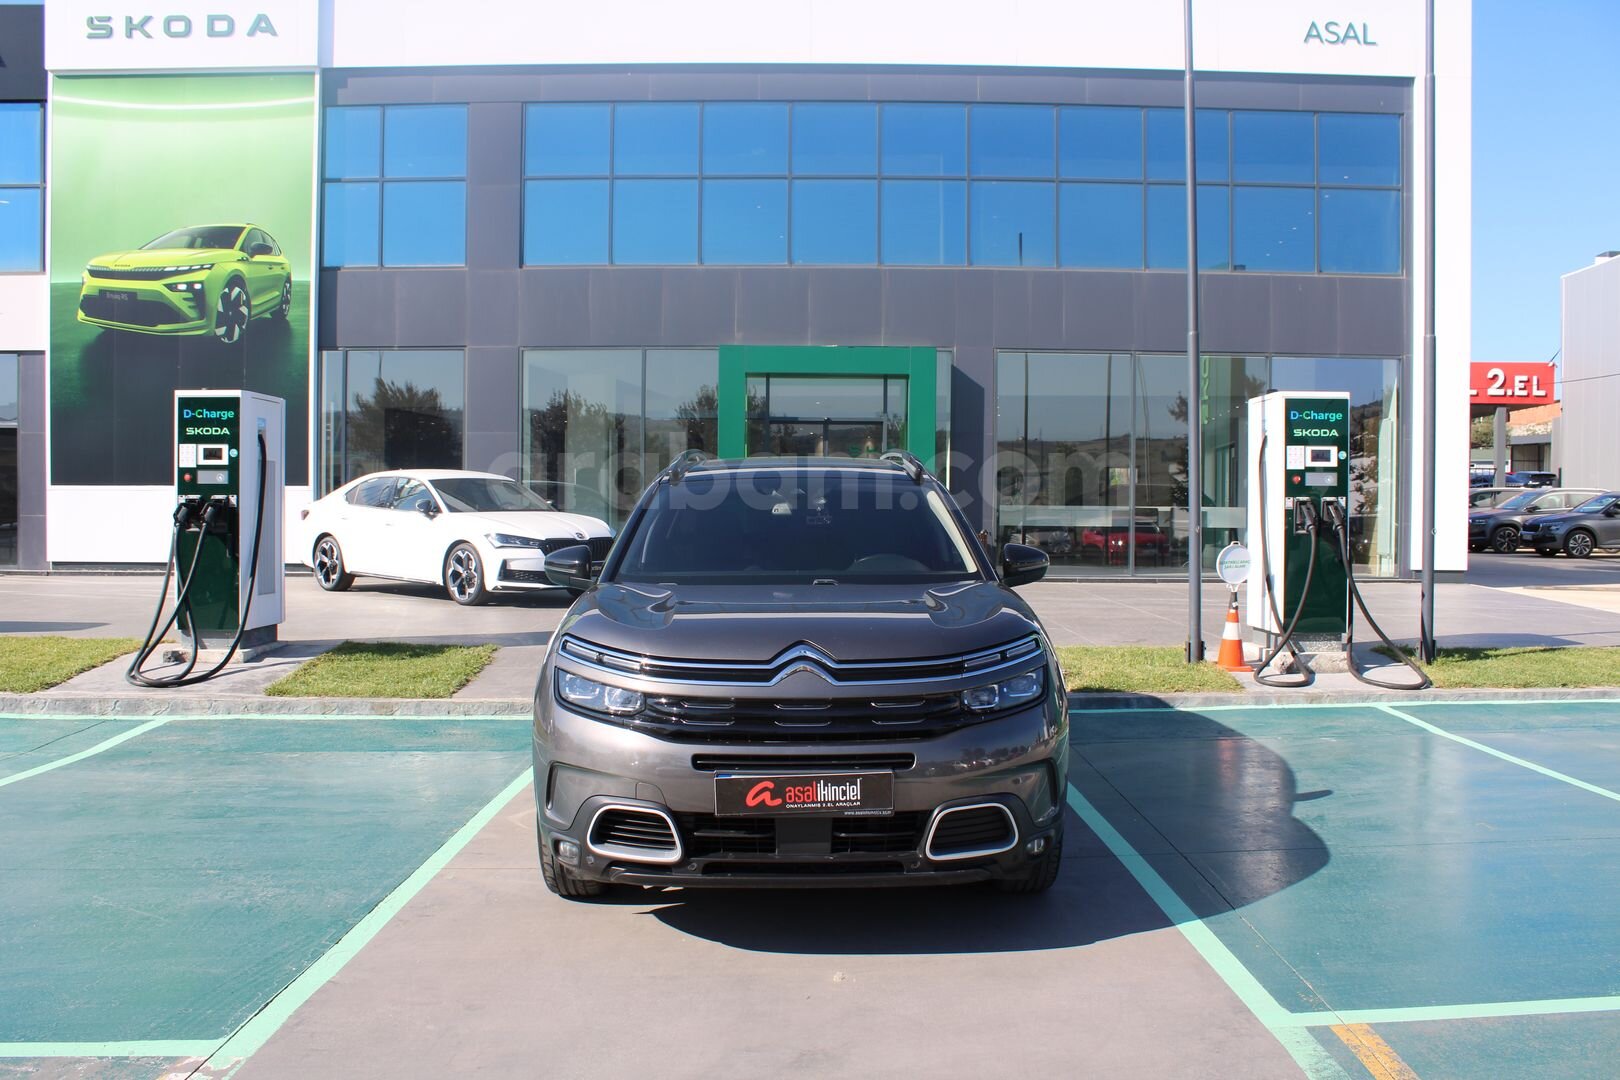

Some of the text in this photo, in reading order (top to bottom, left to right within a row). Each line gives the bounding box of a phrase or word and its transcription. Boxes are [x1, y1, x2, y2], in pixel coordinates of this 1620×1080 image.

[86, 14, 278, 39] SKODA
[1304, 20, 1377, 44] ASAL
[1487, 368, 1547, 396] 2.EL
[183, 409, 234, 420] D-Charge
[1290, 410, 1343, 422] D-Charge
[186, 427, 230, 435] SKODA
[1293, 429, 1339, 437] SKODA
